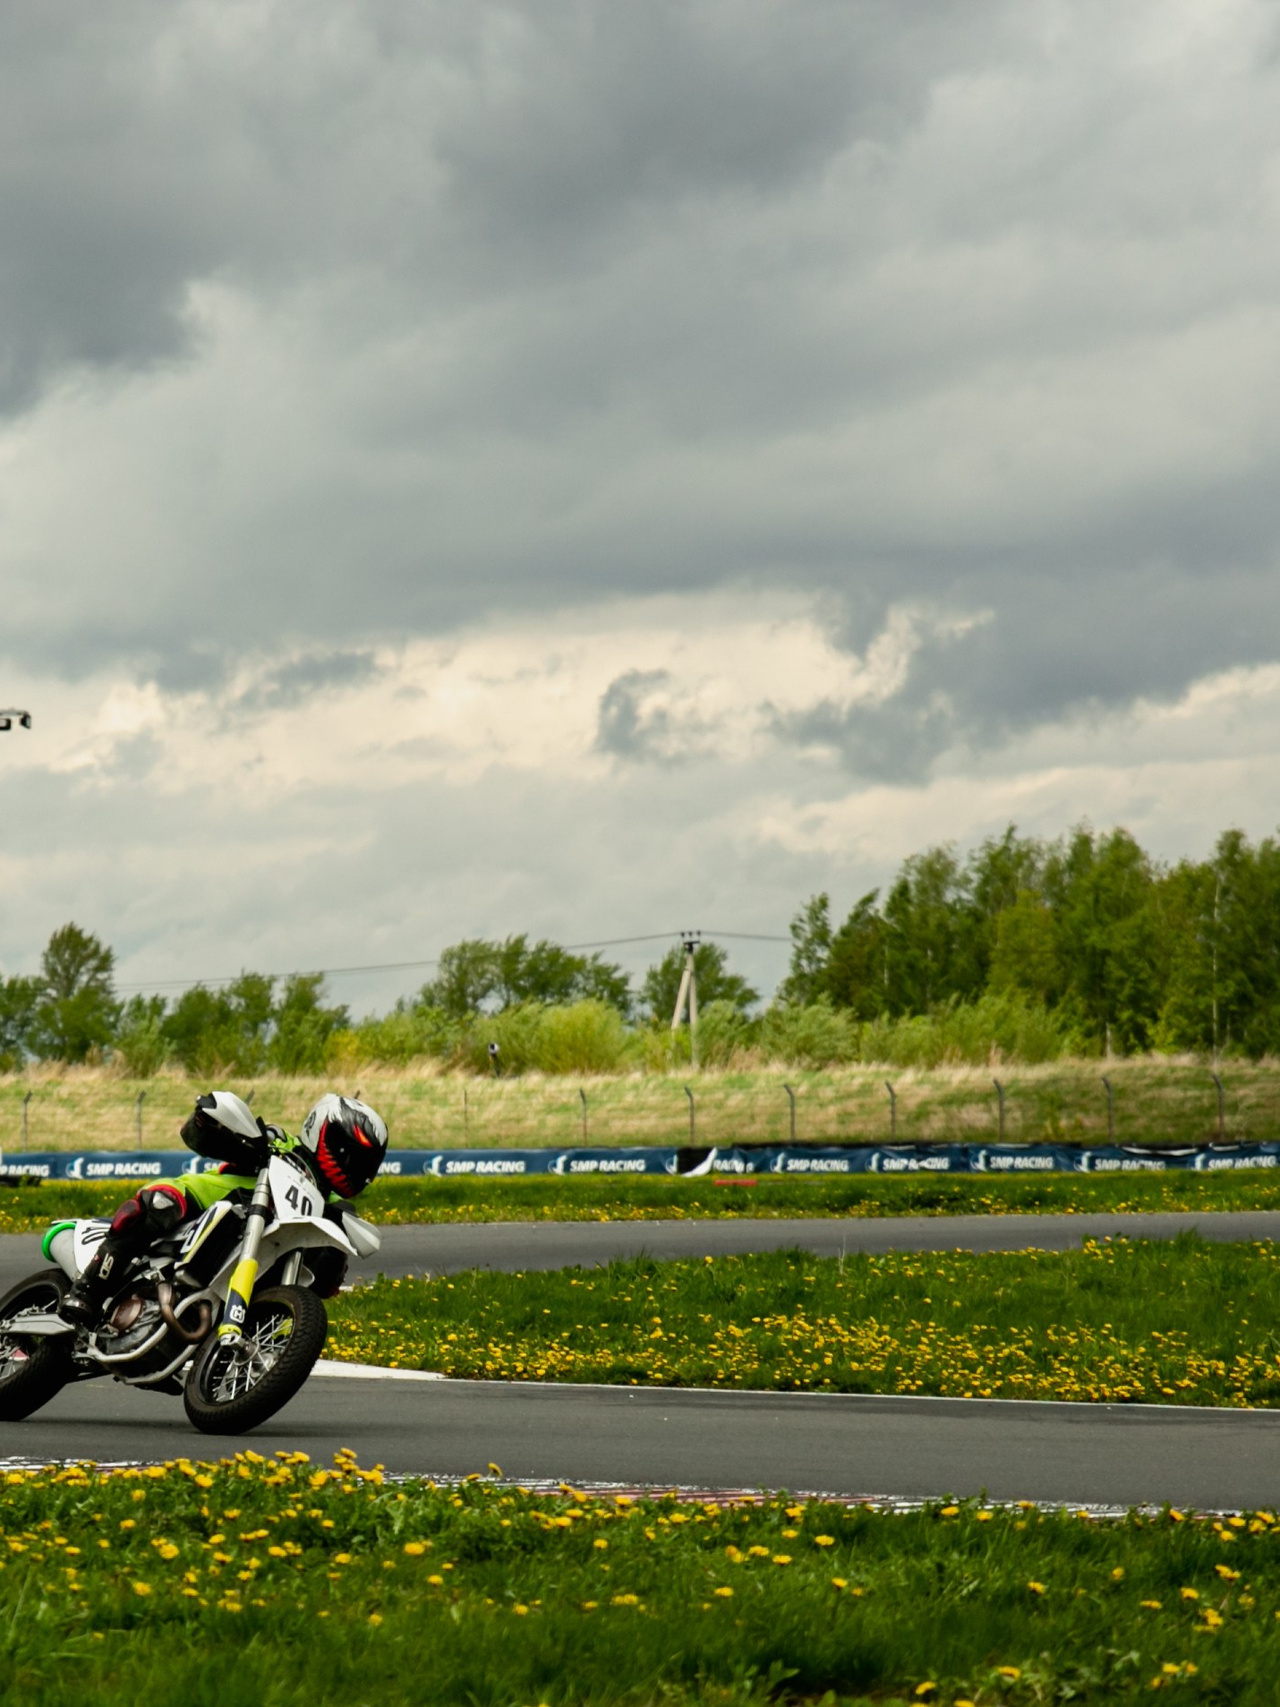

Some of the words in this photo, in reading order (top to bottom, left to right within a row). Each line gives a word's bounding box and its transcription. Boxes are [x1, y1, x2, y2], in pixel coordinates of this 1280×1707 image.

[86, 1162, 114, 1175] SMP
[115, 1162, 161, 1175] RACING
[377, 1162, 401, 1174] ING
[446, 1161, 475, 1174] SMP
[476, 1160, 526, 1173] RACING
[570, 1160, 598, 1172] SMP
[600, 1160, 646, 1172] RACING
[787, 1159, 810, 1171] SMP
[811, 1159, 849, 1172] RACING
[883, 1158, 908, 1171] SMP
[990, 1156, 1013, 1169] SMP
[1014, 1156, 1054, 1169] RACING
[1095, 1159, 1121, 1171] SMP
[1122, 1159, 1166, 1171] RACING
[1208, 1158, 1234, 1171] SMP
[1234, 1155, 1277, 1169] RACING
[9, 1164, 50, 1177] RACING
[285, 1185, 313, 1216] 40
